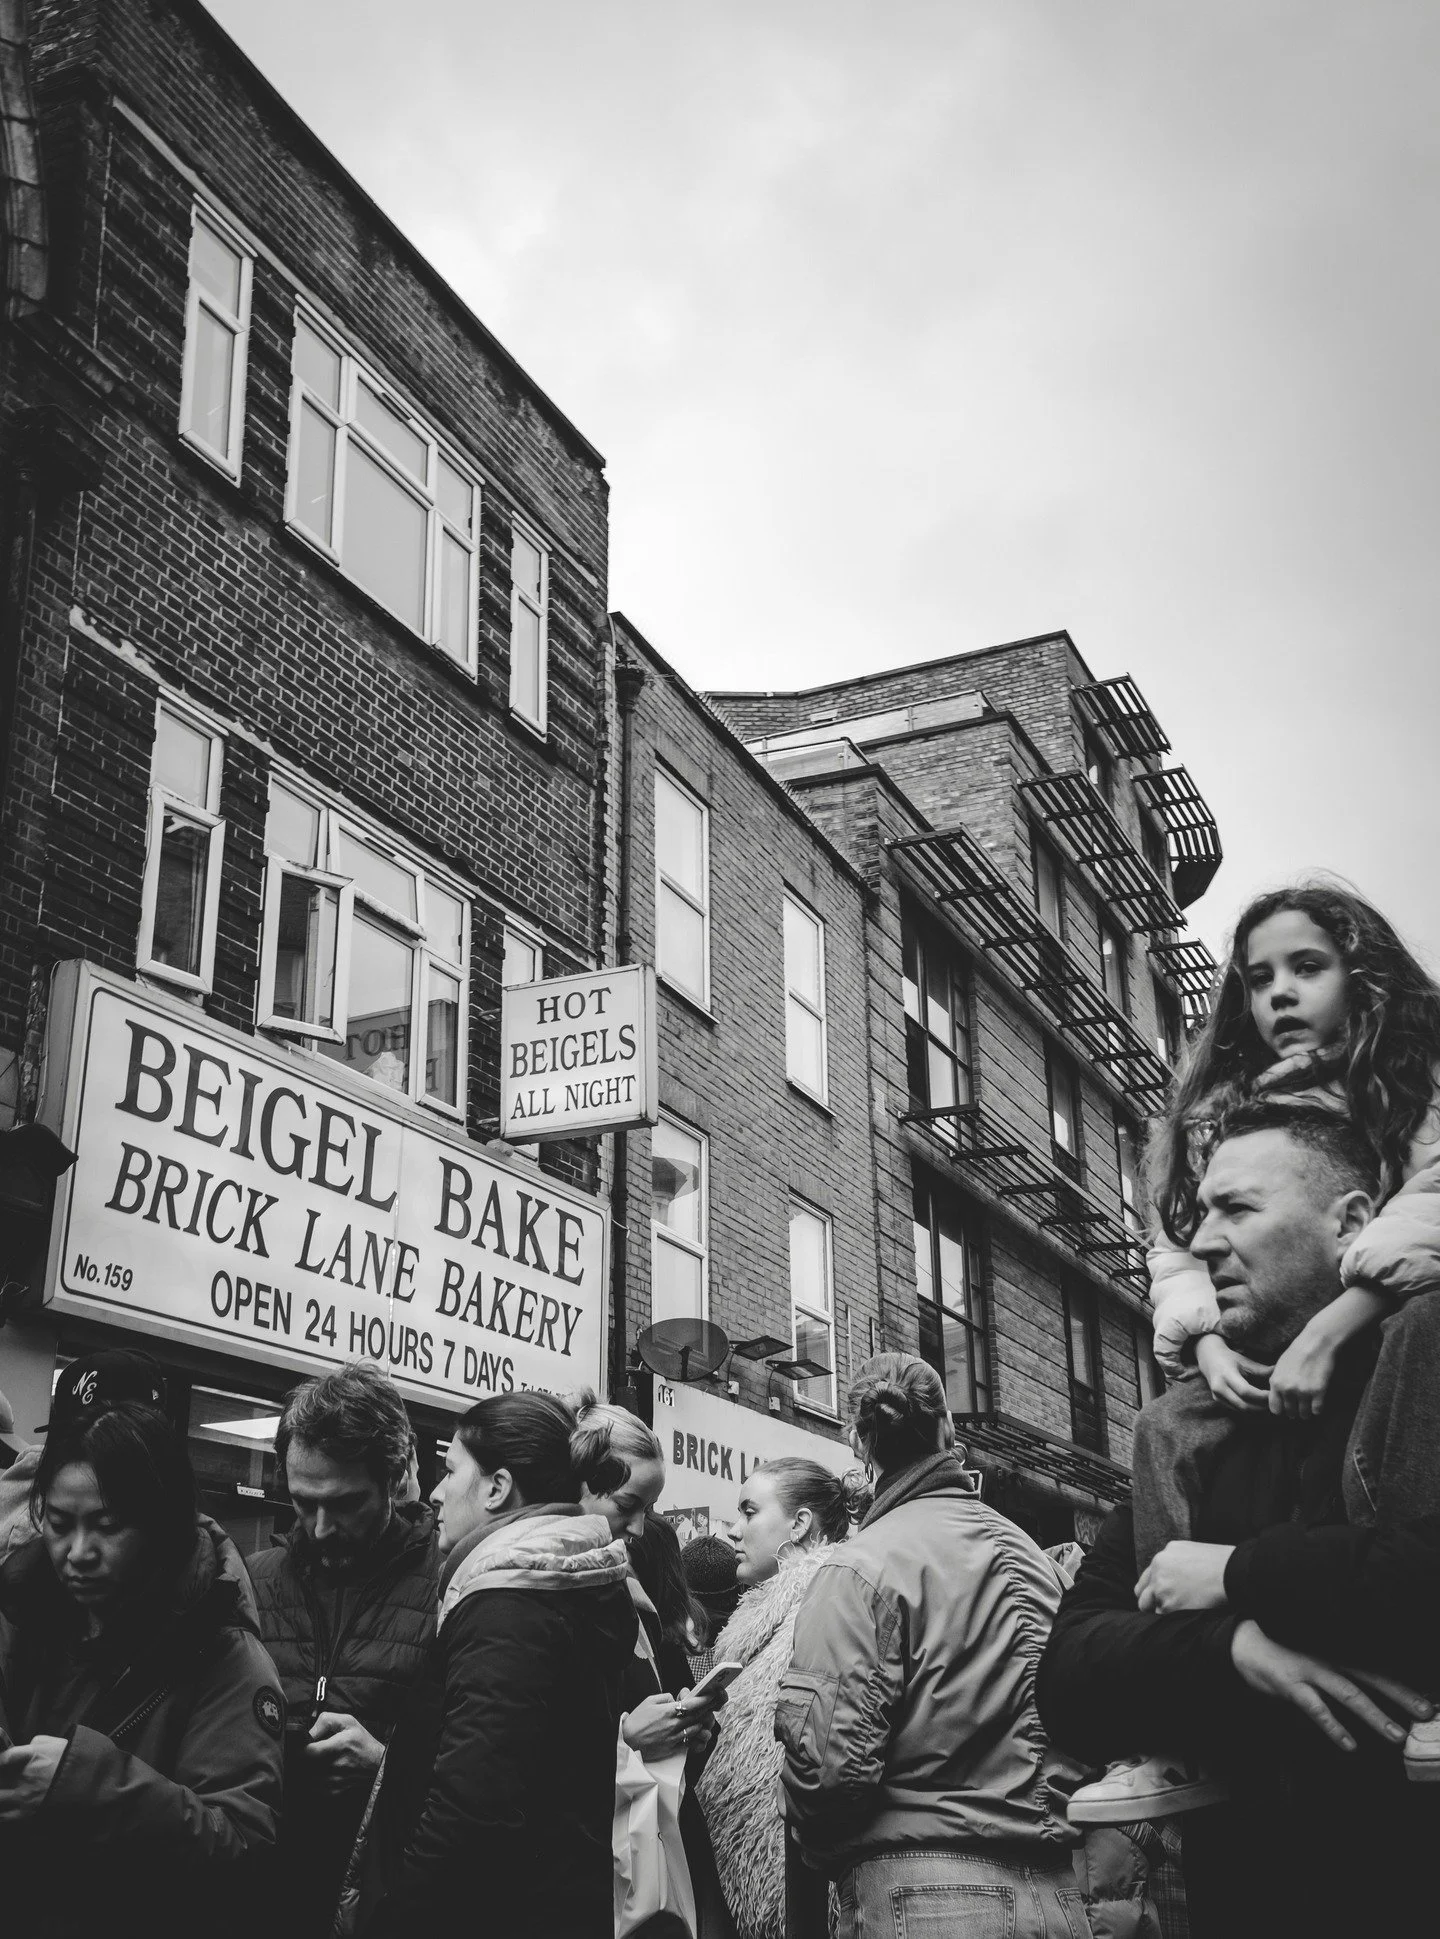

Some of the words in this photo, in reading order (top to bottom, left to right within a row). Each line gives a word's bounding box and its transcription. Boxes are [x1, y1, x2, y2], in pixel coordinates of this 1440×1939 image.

[537, 987, 612, 1025] HOT
[510, 1024, 636, 1078] BEIGELS
[510, 1088, 556, 1119] ALL
[564, 1074, 637, 1112] NIGHT
[115, 1018, 398, 1213] BEIGEL
[433, 1155, 585, 1286] BAKE
[104, 1141, 279, 1259] BRICK
[294, 1208, 420, 1304] LANE
[435, 1258, 583, 1357] BAKERY
[210, 1269, 293, 1335] OPEN
[305, 1298, 337, 1348] 24
[349, 1310, 433, 1374] HOURS
[443, 1338, 456, 1379] 7
[464, 1345, 514, 1393] DAYS
[658, 1384, 675, 1407] 161
[673, 1429, 733, 1481] BRICK
